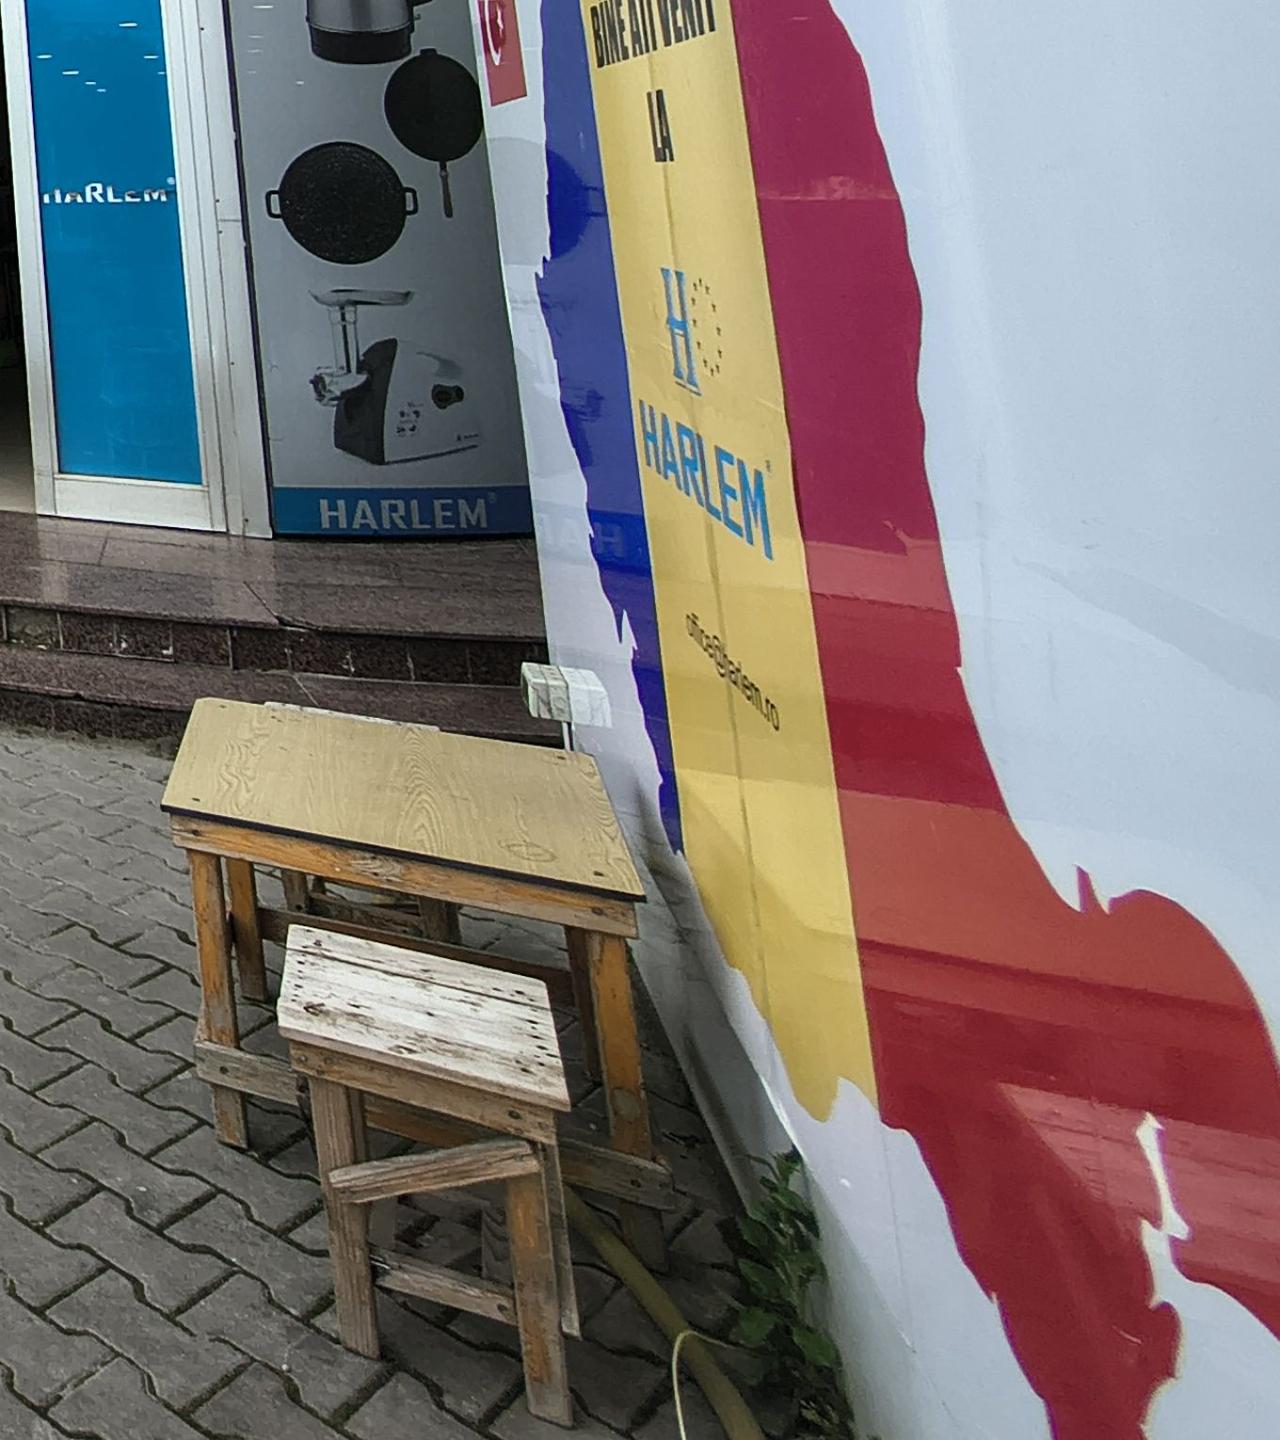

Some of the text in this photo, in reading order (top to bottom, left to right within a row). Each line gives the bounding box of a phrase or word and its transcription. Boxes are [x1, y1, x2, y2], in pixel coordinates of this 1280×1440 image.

[646, 89, 675, 162] LA
[319, 498, 488, 530] HARLEM
[639, 399, 774, 561] HARLEM
